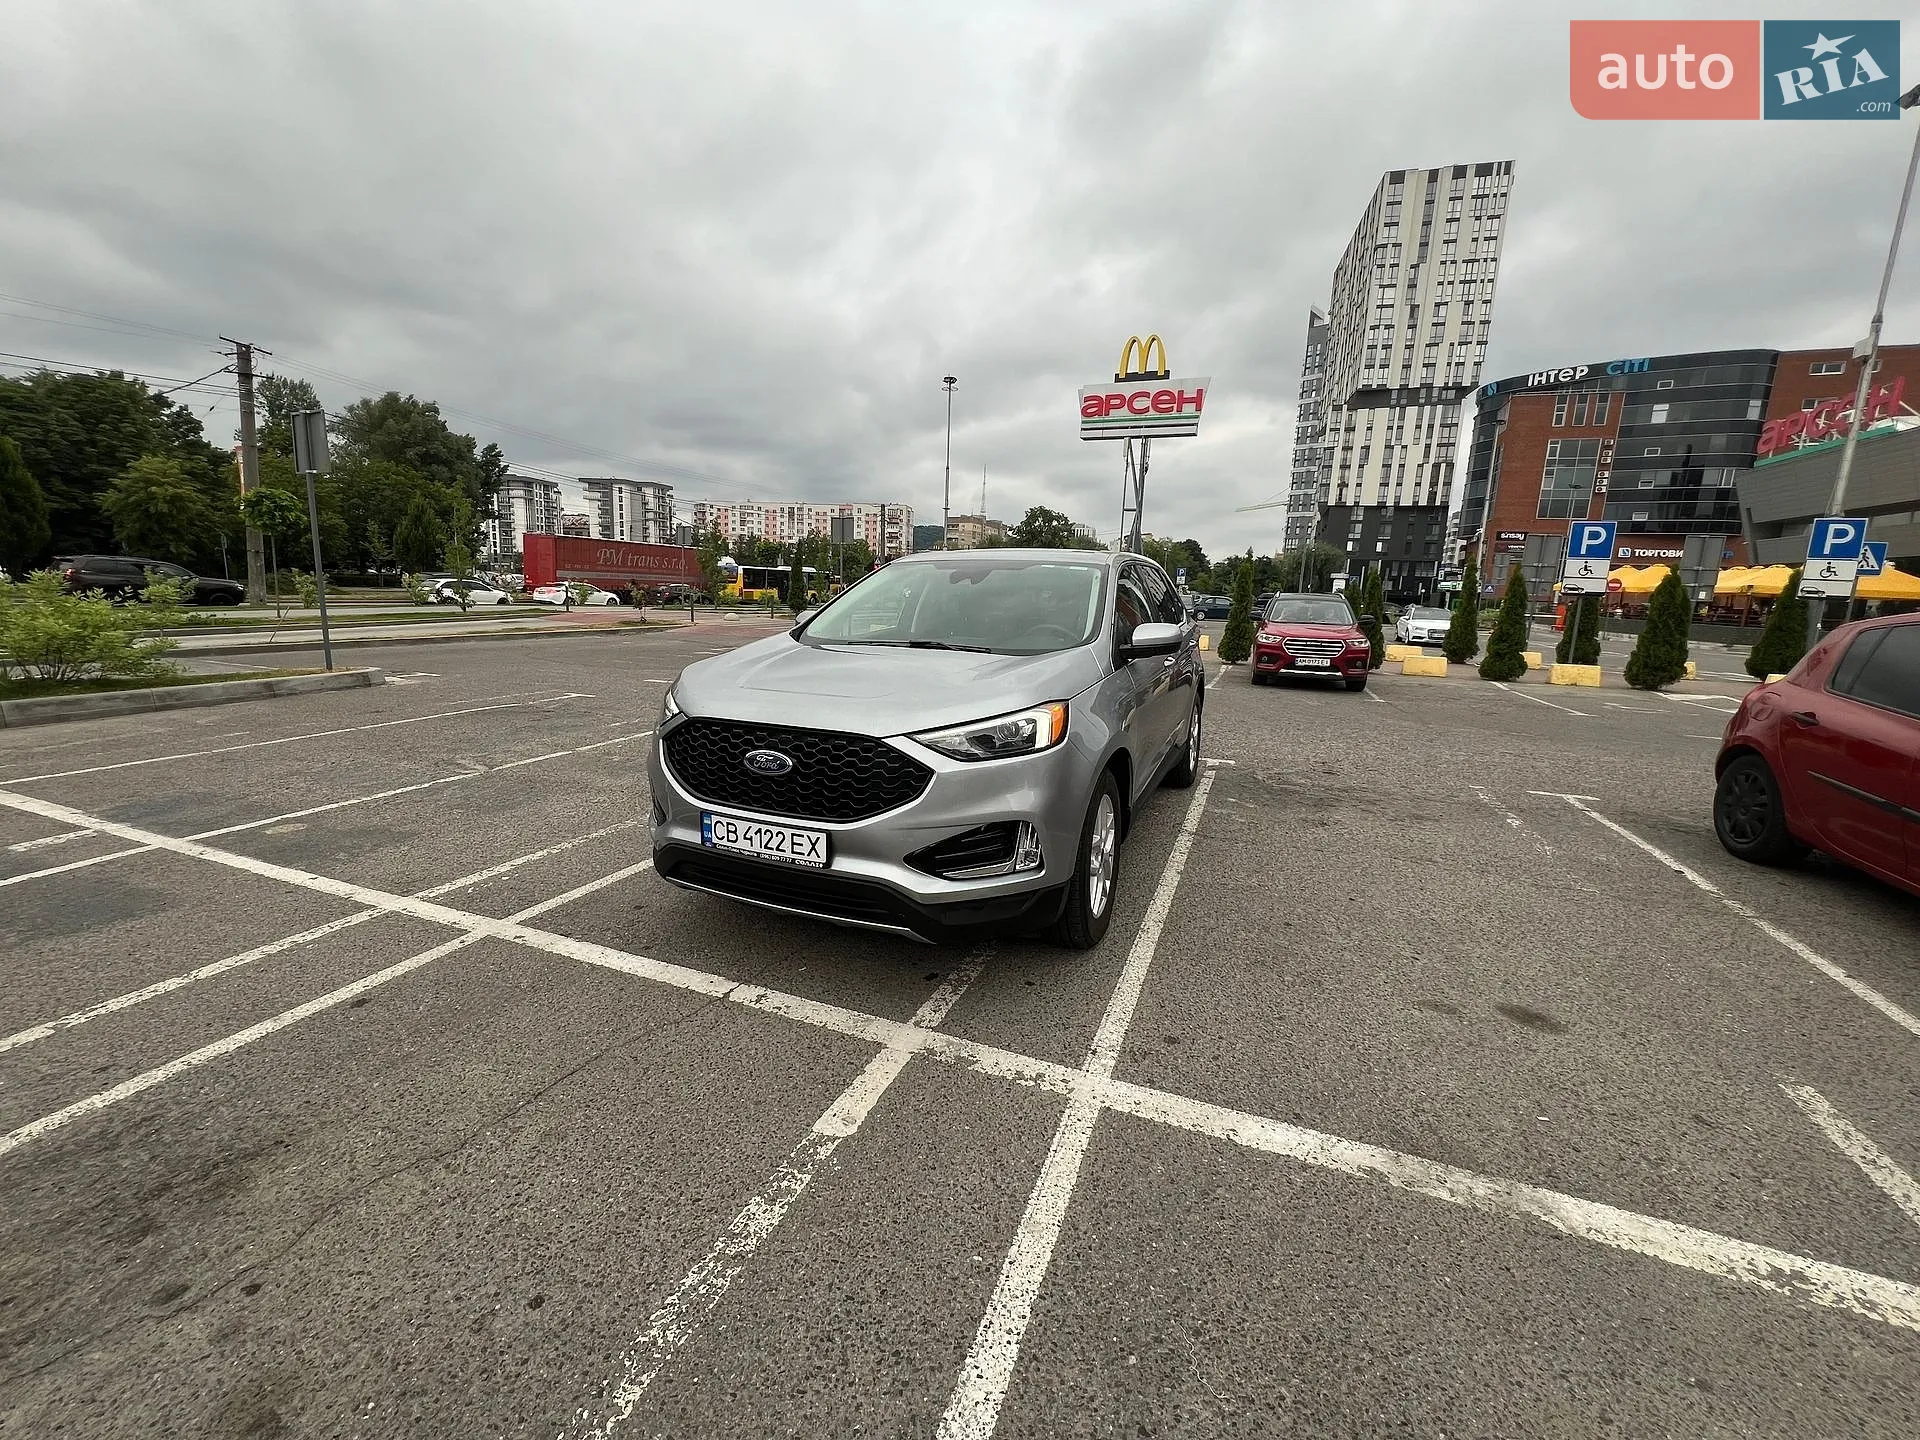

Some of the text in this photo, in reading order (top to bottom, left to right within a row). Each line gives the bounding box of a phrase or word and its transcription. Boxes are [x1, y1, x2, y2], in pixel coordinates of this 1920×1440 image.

[1580, 526, 1607, 555] P
[1633, 548, 1685, 558] ТОРГОВИ
[1822, 523, 1855, 555] P
[753, 754, 781, 770] Ford
[713, 820, 739, 844] CB
[743, 825, 787, 853] 4122
[790, 832, 821, 859] EX
